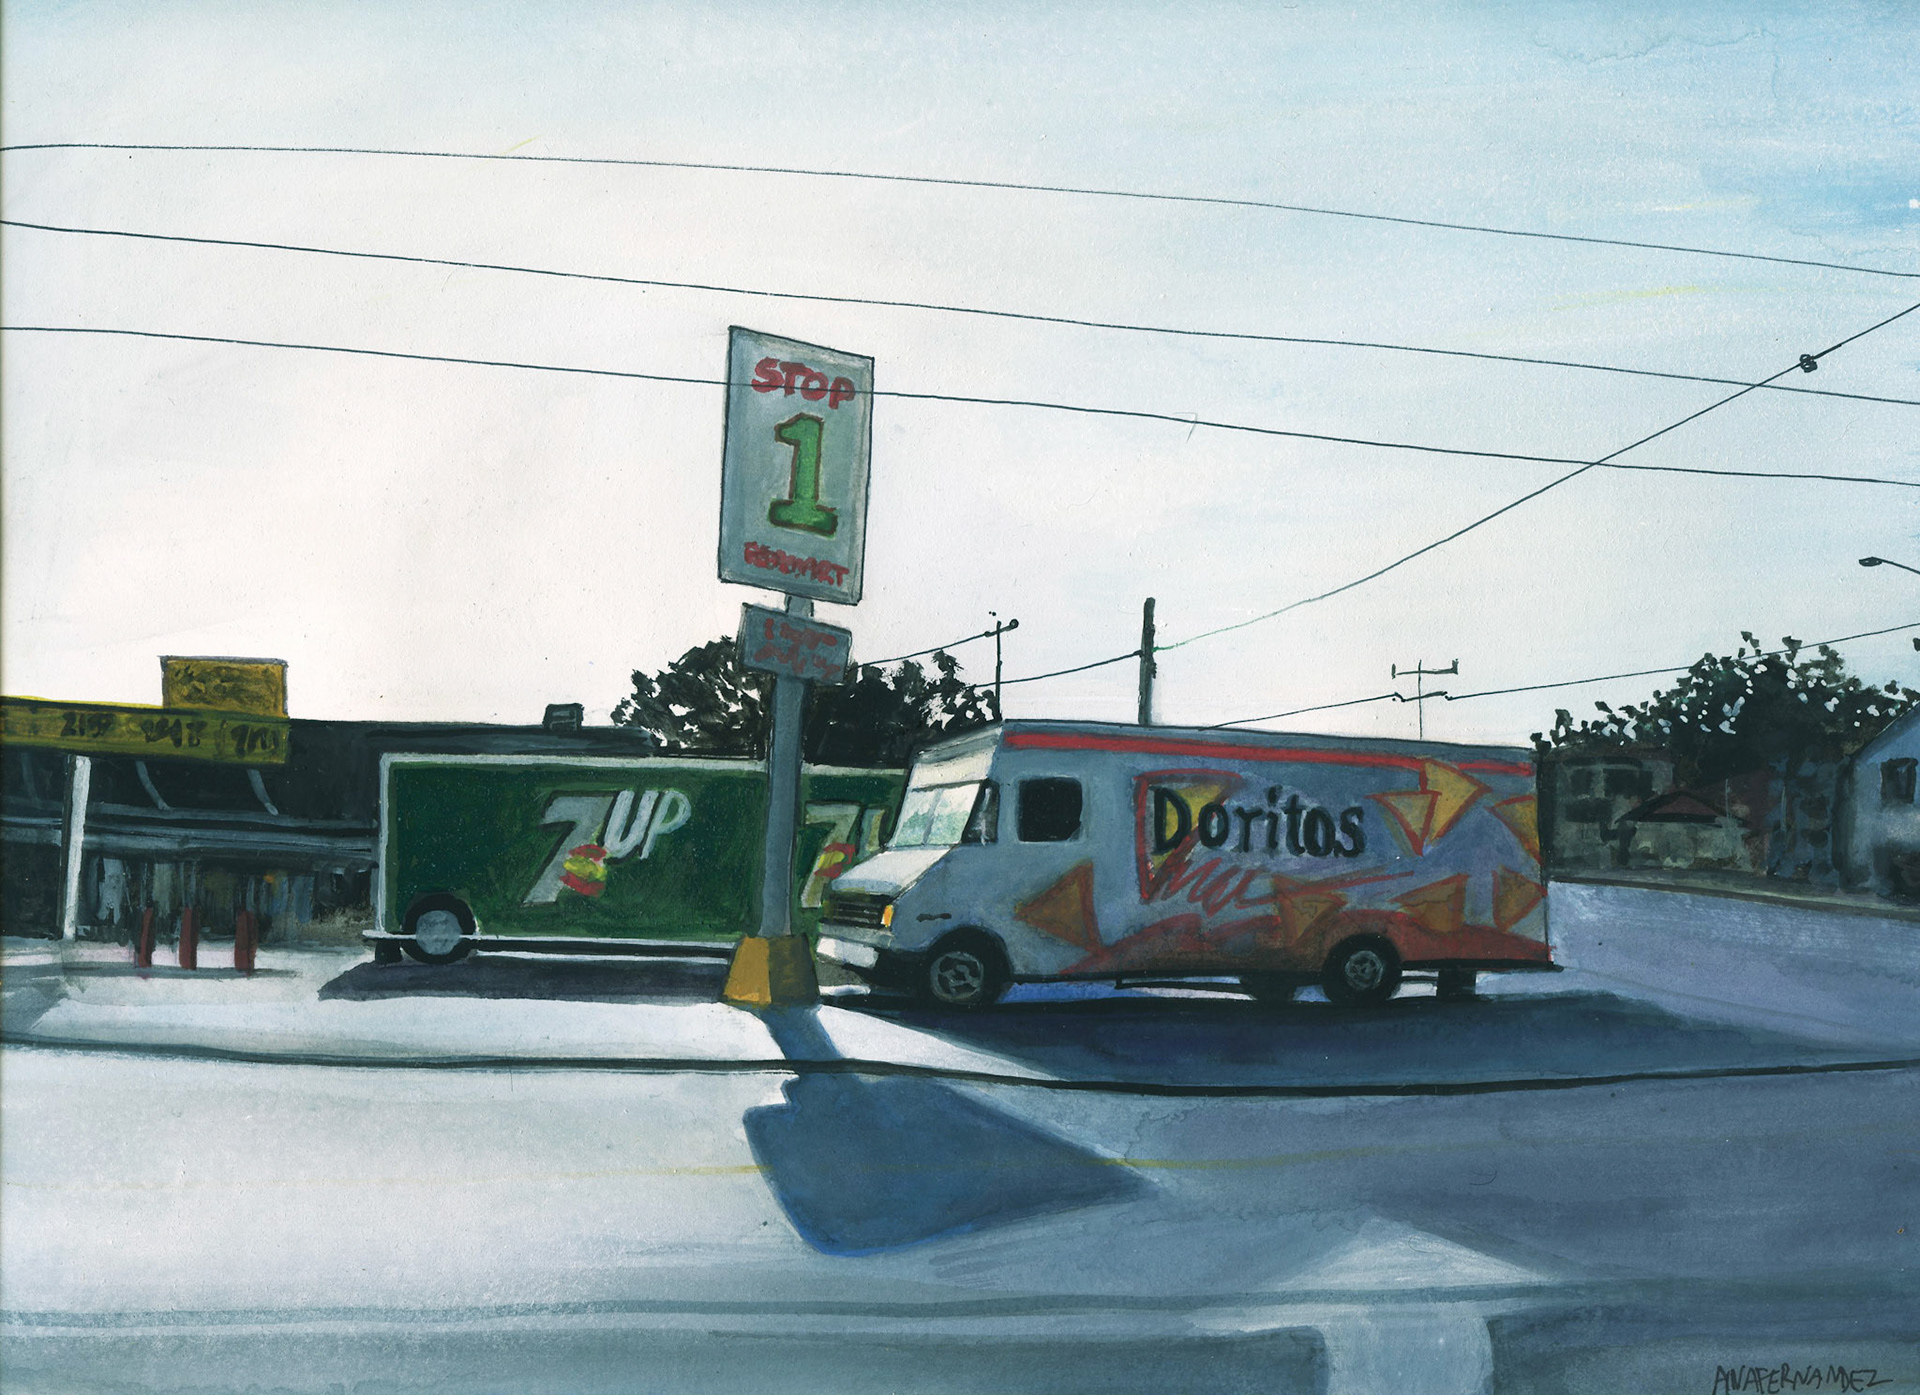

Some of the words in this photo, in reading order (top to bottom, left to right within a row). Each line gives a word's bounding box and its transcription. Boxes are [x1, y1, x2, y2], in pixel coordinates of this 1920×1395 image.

[752, 357, 855, 409] STOP
[767, 412, 837, 537] 1
[1149, 785, 1367, 857] Doritos
